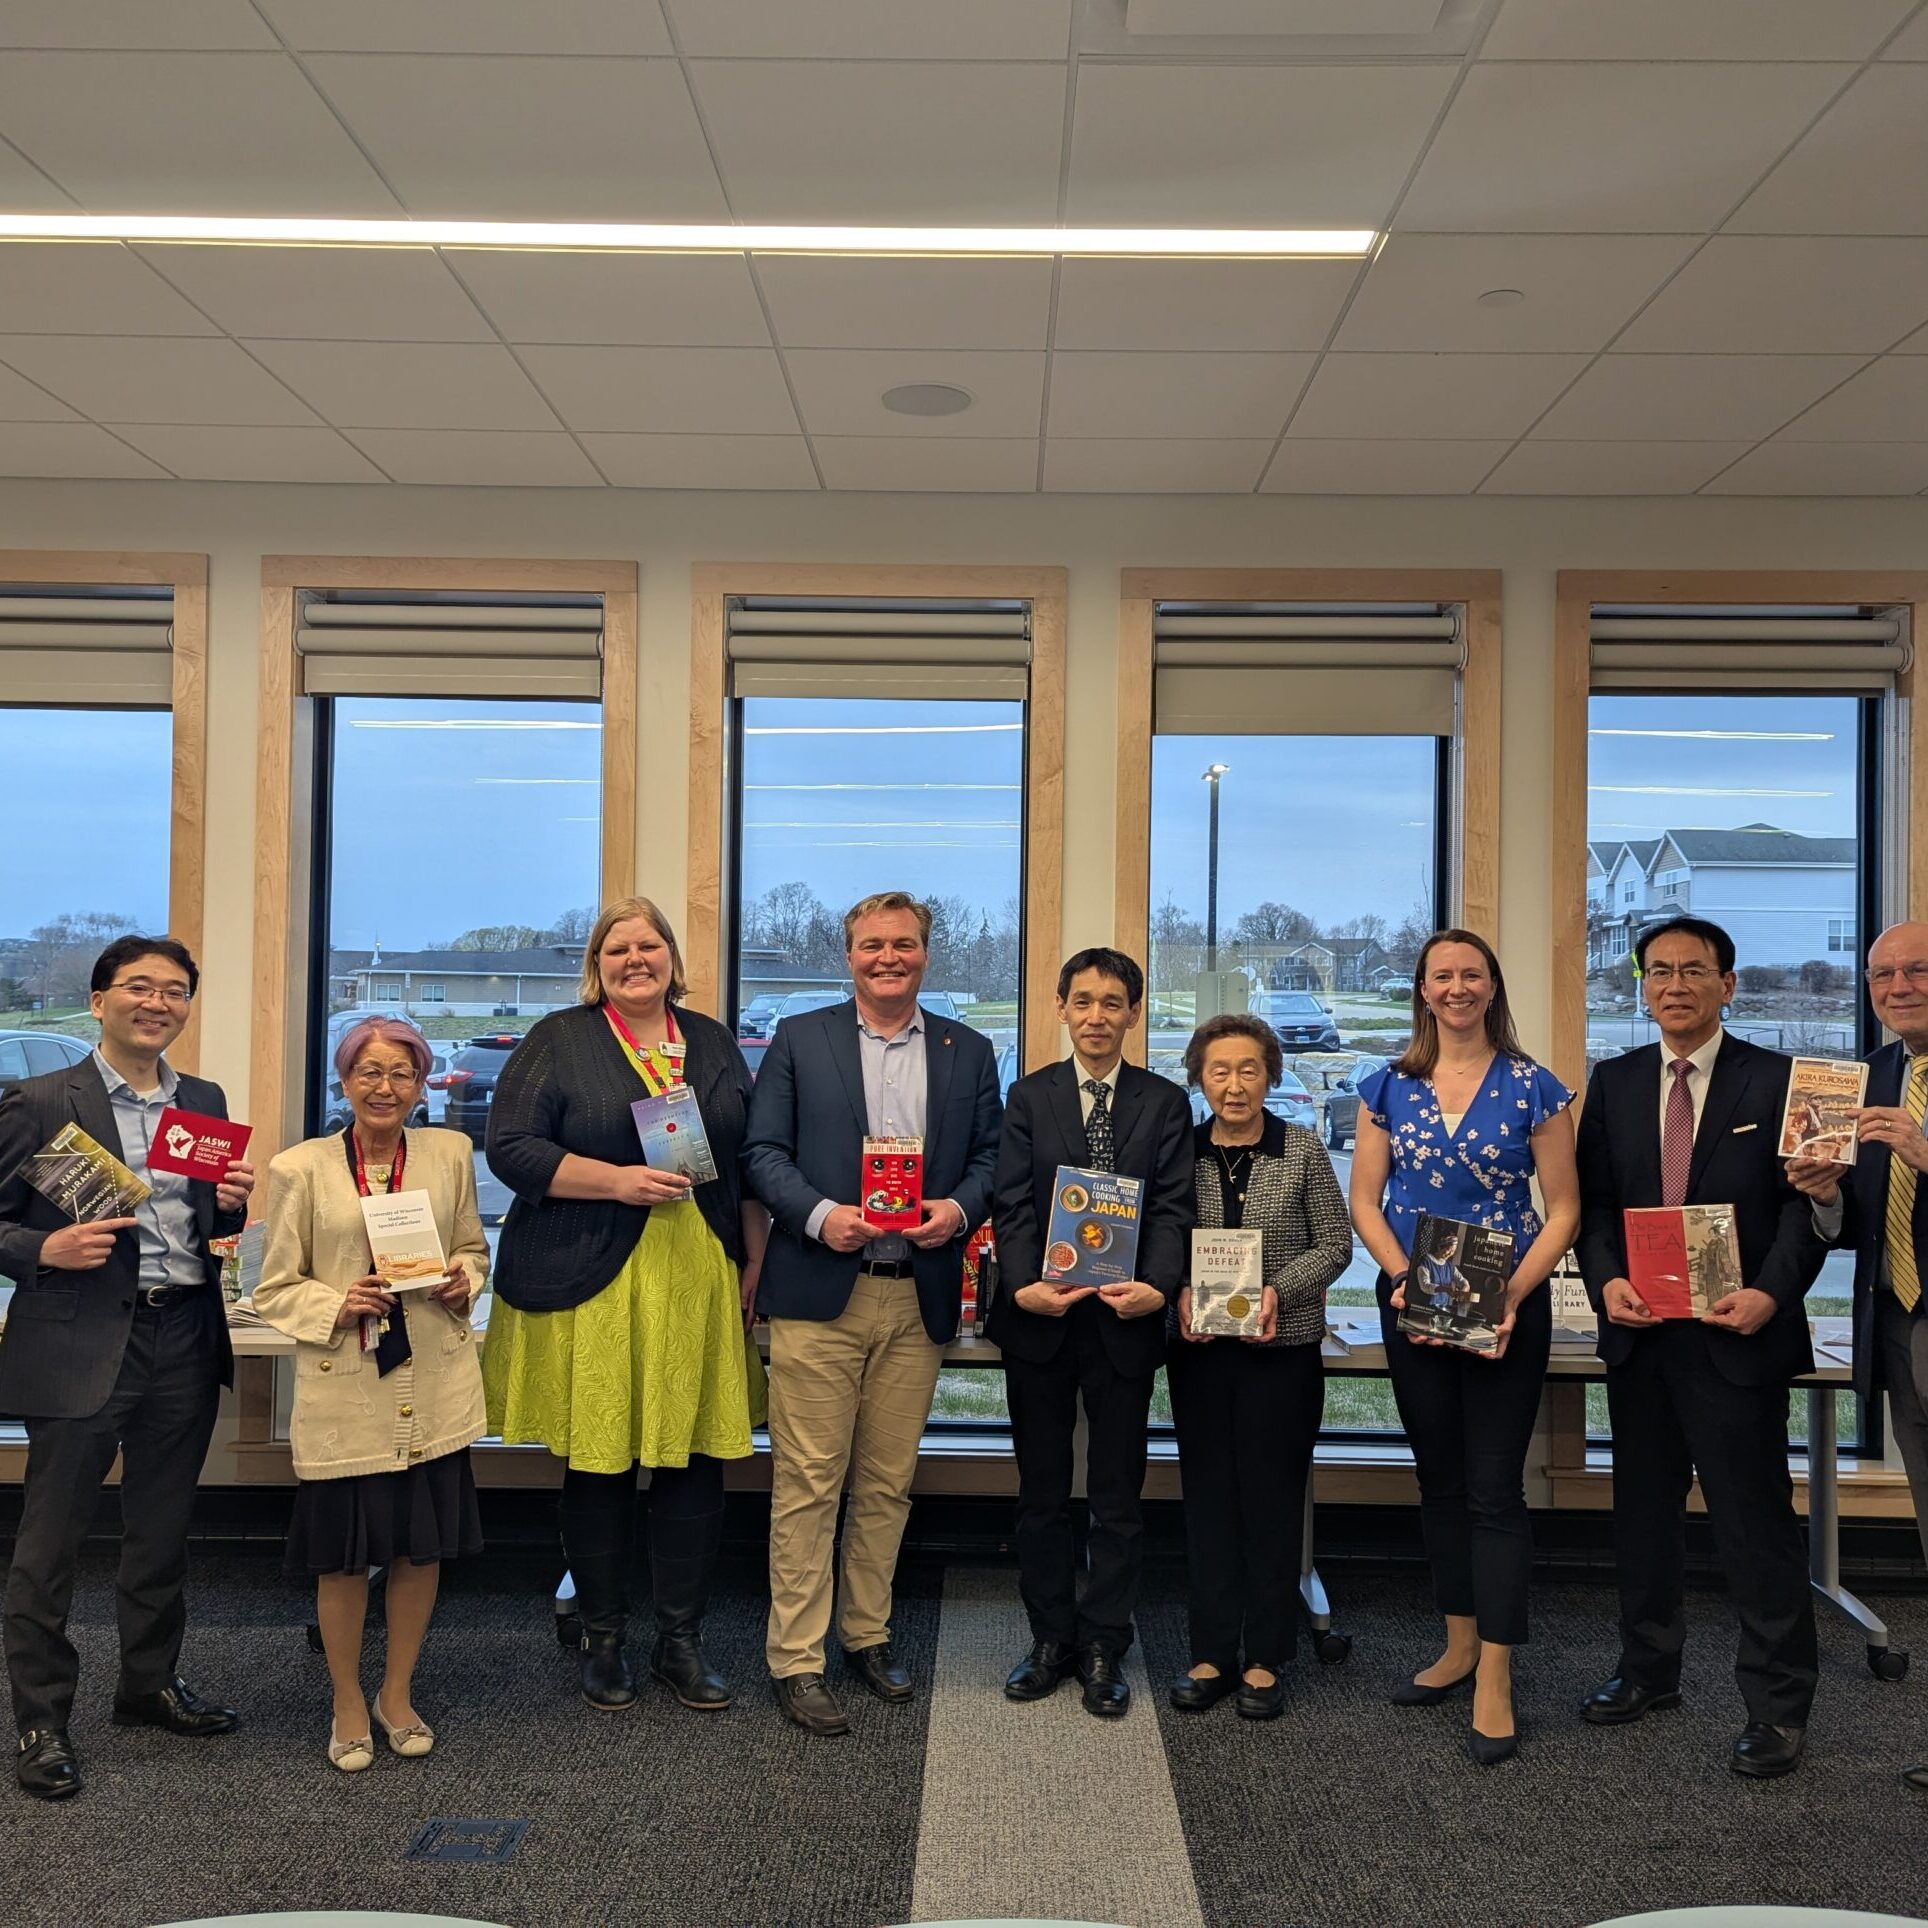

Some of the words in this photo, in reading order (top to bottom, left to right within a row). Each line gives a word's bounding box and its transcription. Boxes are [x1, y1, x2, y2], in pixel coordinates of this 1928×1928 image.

[1796, 1072, 1817, 1081] AKIRA
[1818, 1073, 1859, 1086] KUROSAWA
[198, 1135, 232, 1149] JASWI
[195, 1151, 213, 1160] Society
[58, 1156, 91, 1186] HARUKI
[61, 1157, 107, 1200] MURAKAMI
[1092, 1182, 1118, 1194] CLASSIC
[1120, 1187, 1139, 1198] HOME
[78, 1182, 113, 1216] NORWEGIAN
[93, 1195, 113, 1214] WOOD
[1091, 1191, 1121, 1204] COOKING
[369, 1210, 393, 1219] University
[400, 1206, 424, 1214] Wisconsin
[1091, 1200, 1137, 1219] JAPAN
[1630, 1233, 1682, 1250] TEA
[388, 1250, 433, 1262] LIBRARIES
[1196, 1246, 1258, 1256] EMBRACING
[1484, 1246, 1505, 1256] home
[1207, 1257, 1246, 1266] DEFEAT
[1473, 1254, 1504, 1268] cooking
[1564, 1284, 1587, 1296] Fun
